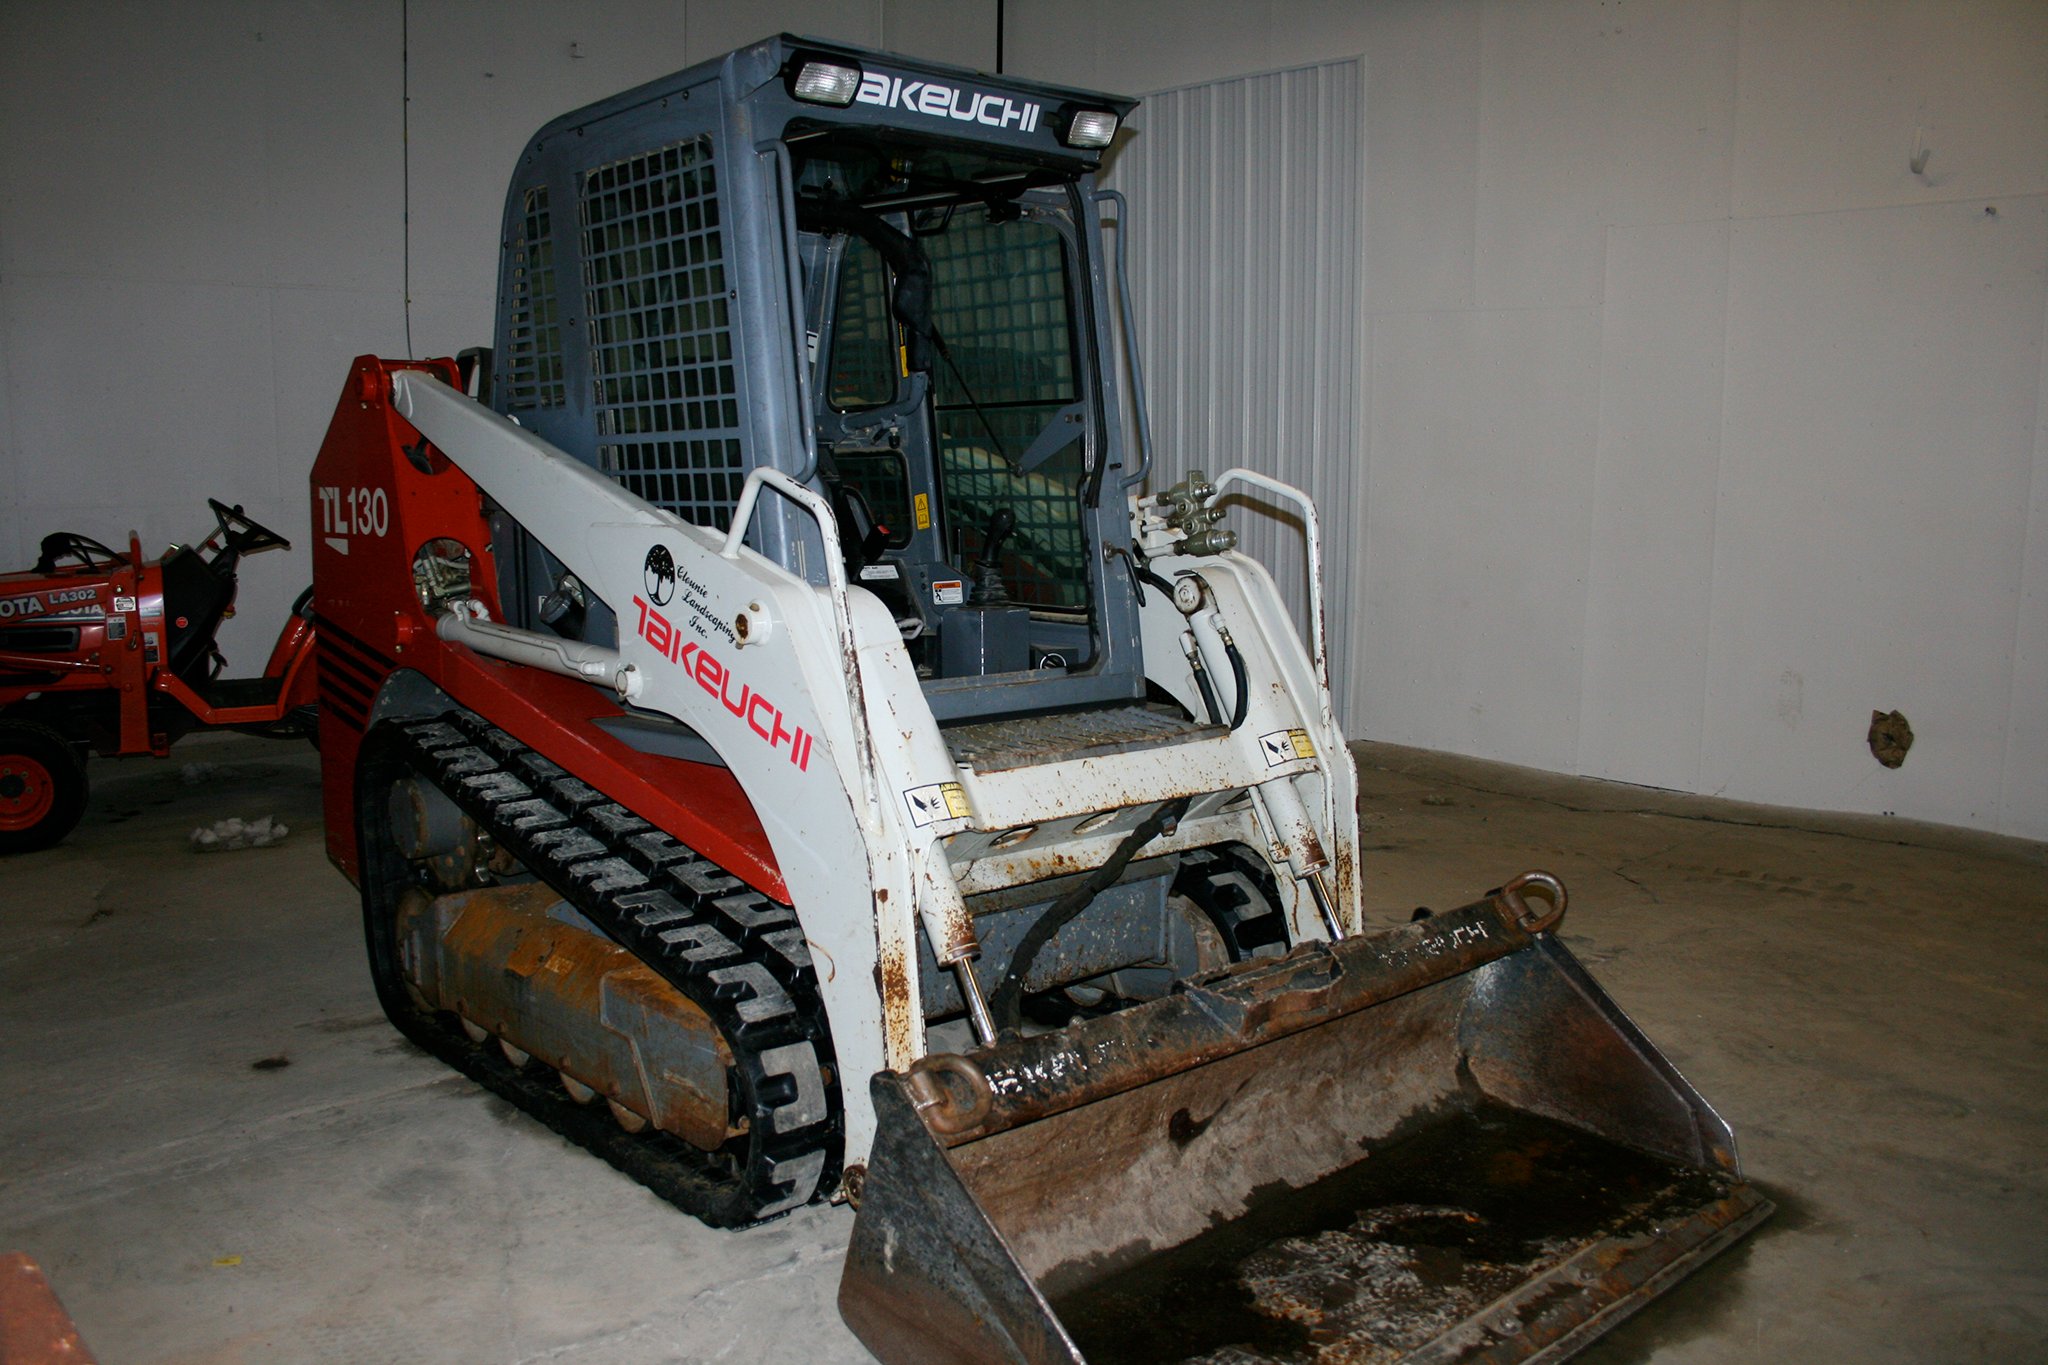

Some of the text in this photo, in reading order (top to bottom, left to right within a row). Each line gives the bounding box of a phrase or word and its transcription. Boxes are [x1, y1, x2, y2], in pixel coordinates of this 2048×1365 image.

[318, 486, 389, 538] TL130
[49, 588, 97, 605] LA302
[681, 588, 736, 644] Landscaping
[688, 615, 709, 639] Inc.
